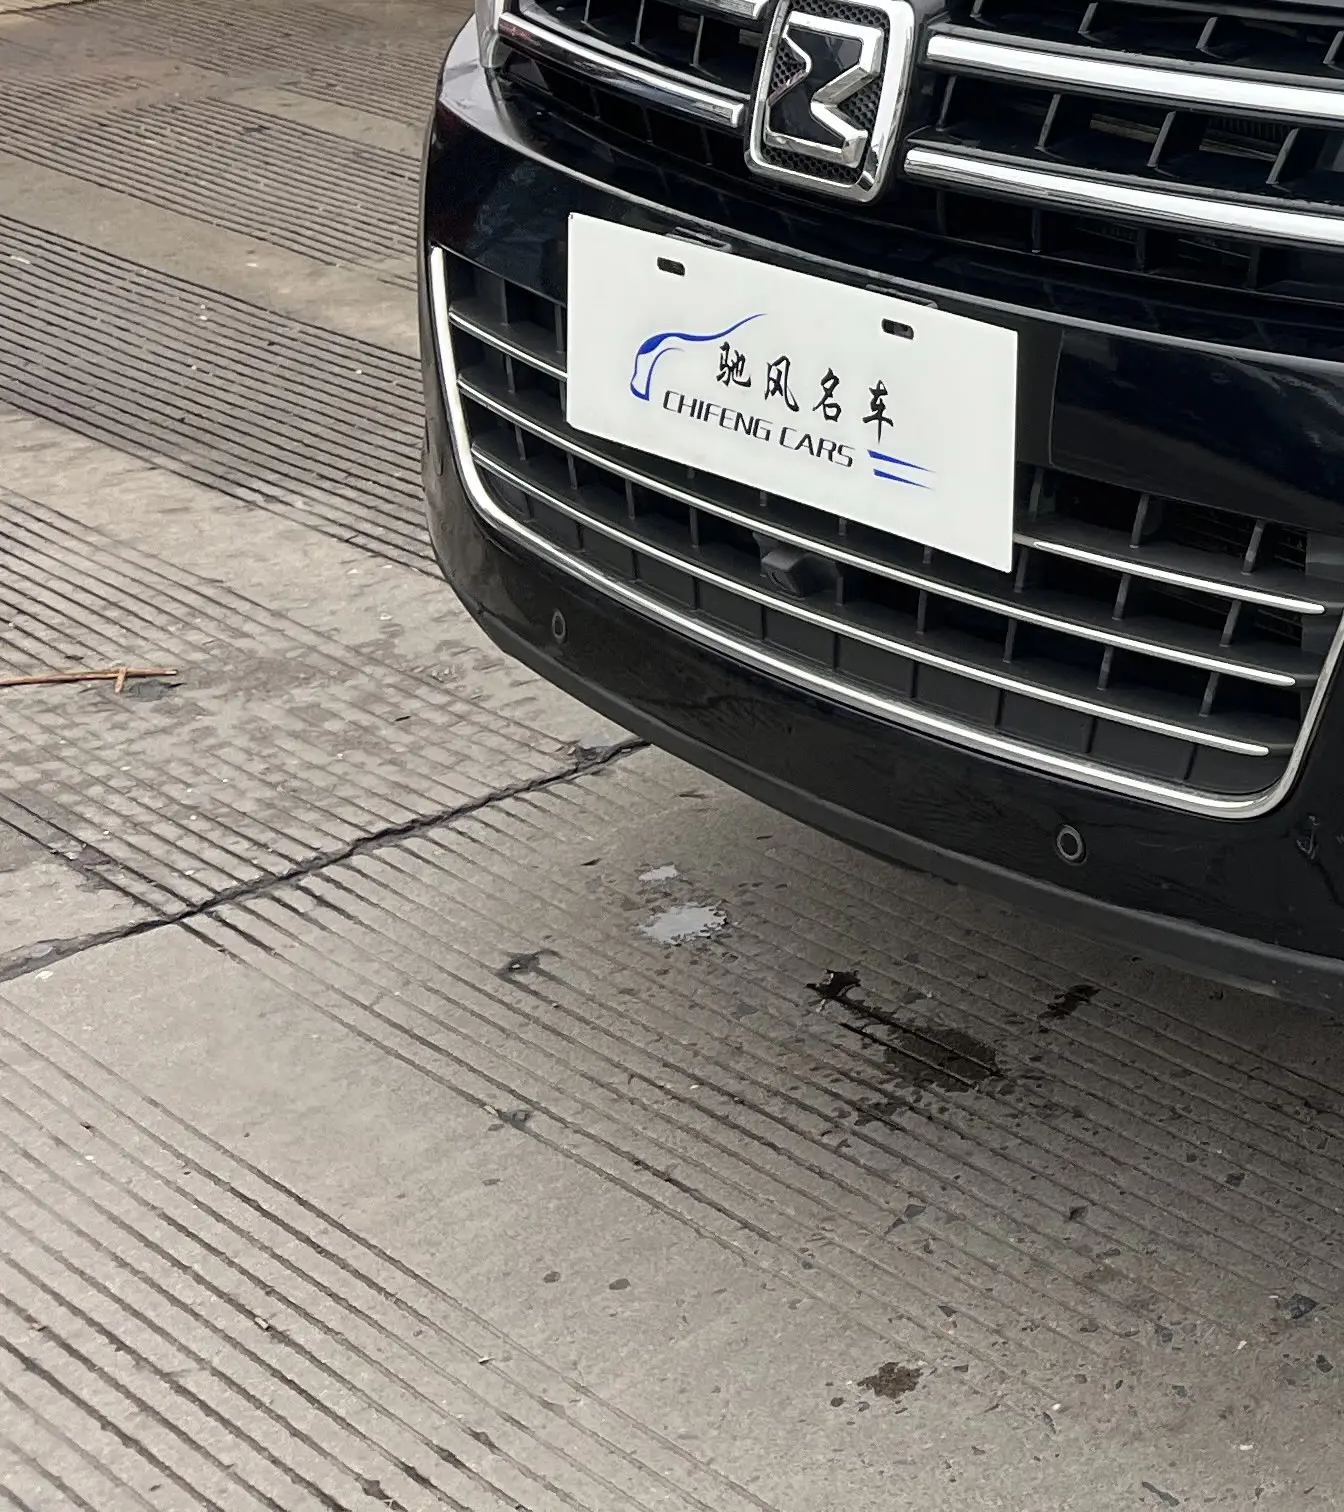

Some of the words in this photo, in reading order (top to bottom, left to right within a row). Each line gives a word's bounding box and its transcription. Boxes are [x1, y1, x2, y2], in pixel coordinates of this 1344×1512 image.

[661, 389, 771, 442] CHIFENG
[778, 426, 853, 468] CARS
[715, 341, 895, 443] 驰风名车
